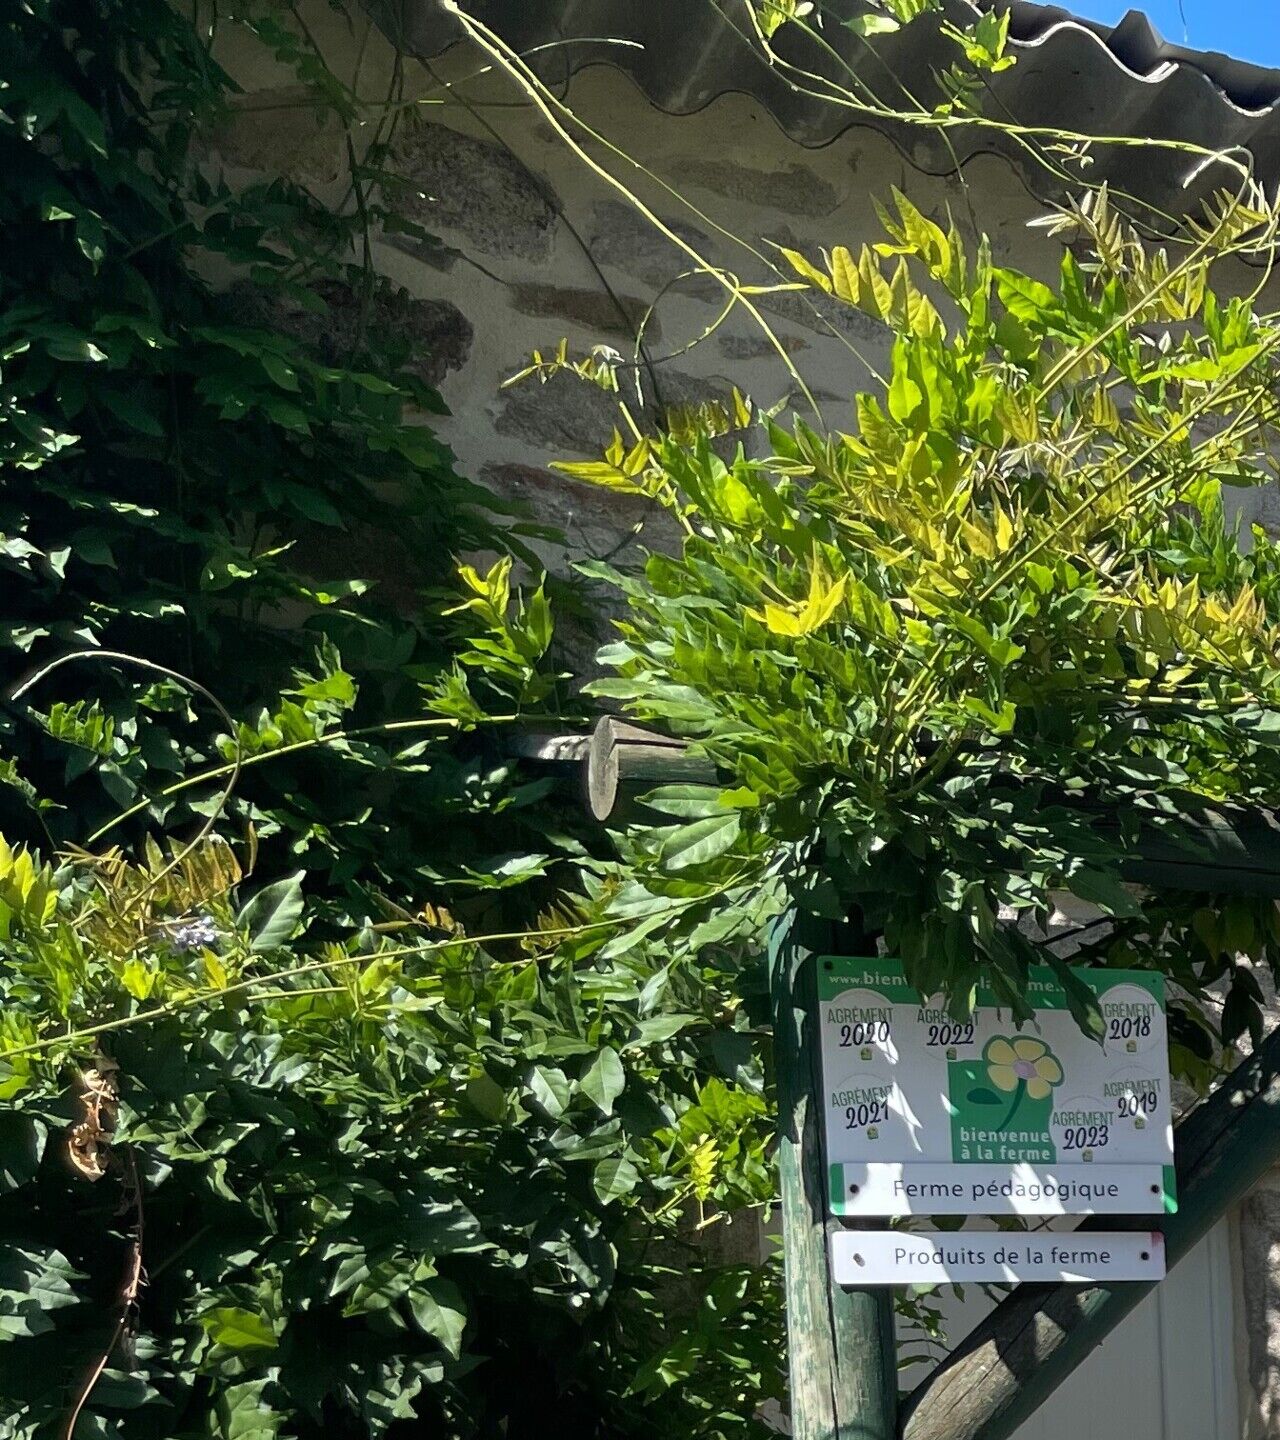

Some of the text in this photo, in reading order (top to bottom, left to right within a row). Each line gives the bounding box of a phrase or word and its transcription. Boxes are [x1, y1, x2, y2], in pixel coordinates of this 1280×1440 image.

[827, 1005, 894, 1024] AGRÉMENT
[1103, 1001, 1157, 1018] GRÉMENT
[839, 1021, 890, 1047] 2020
[926, 1023, 974, 1046] 2022
[1109, 1015, 1151, 1040] 2018
[831, 1084, 894, 1108] AGRÉMENT
[1103, 1078, 1161, 1097] AGRÉMENT
[846, 1099, 889, 1130] 2021
[1118, 1091, 1157, 1118] 2019
[1052, 1108, 1115, 1126] AGRÉMENT
[960, 1127, 1050, 1143] bienvenue
[1063, 1125, 1109, 1150] 2023
[961, 1145, 1050, 1161] à la ferme
[893, 1179, 1119, 1201] Ferme pédagogique
[895, 1246, 1112, 1265] Produits de la ferme
